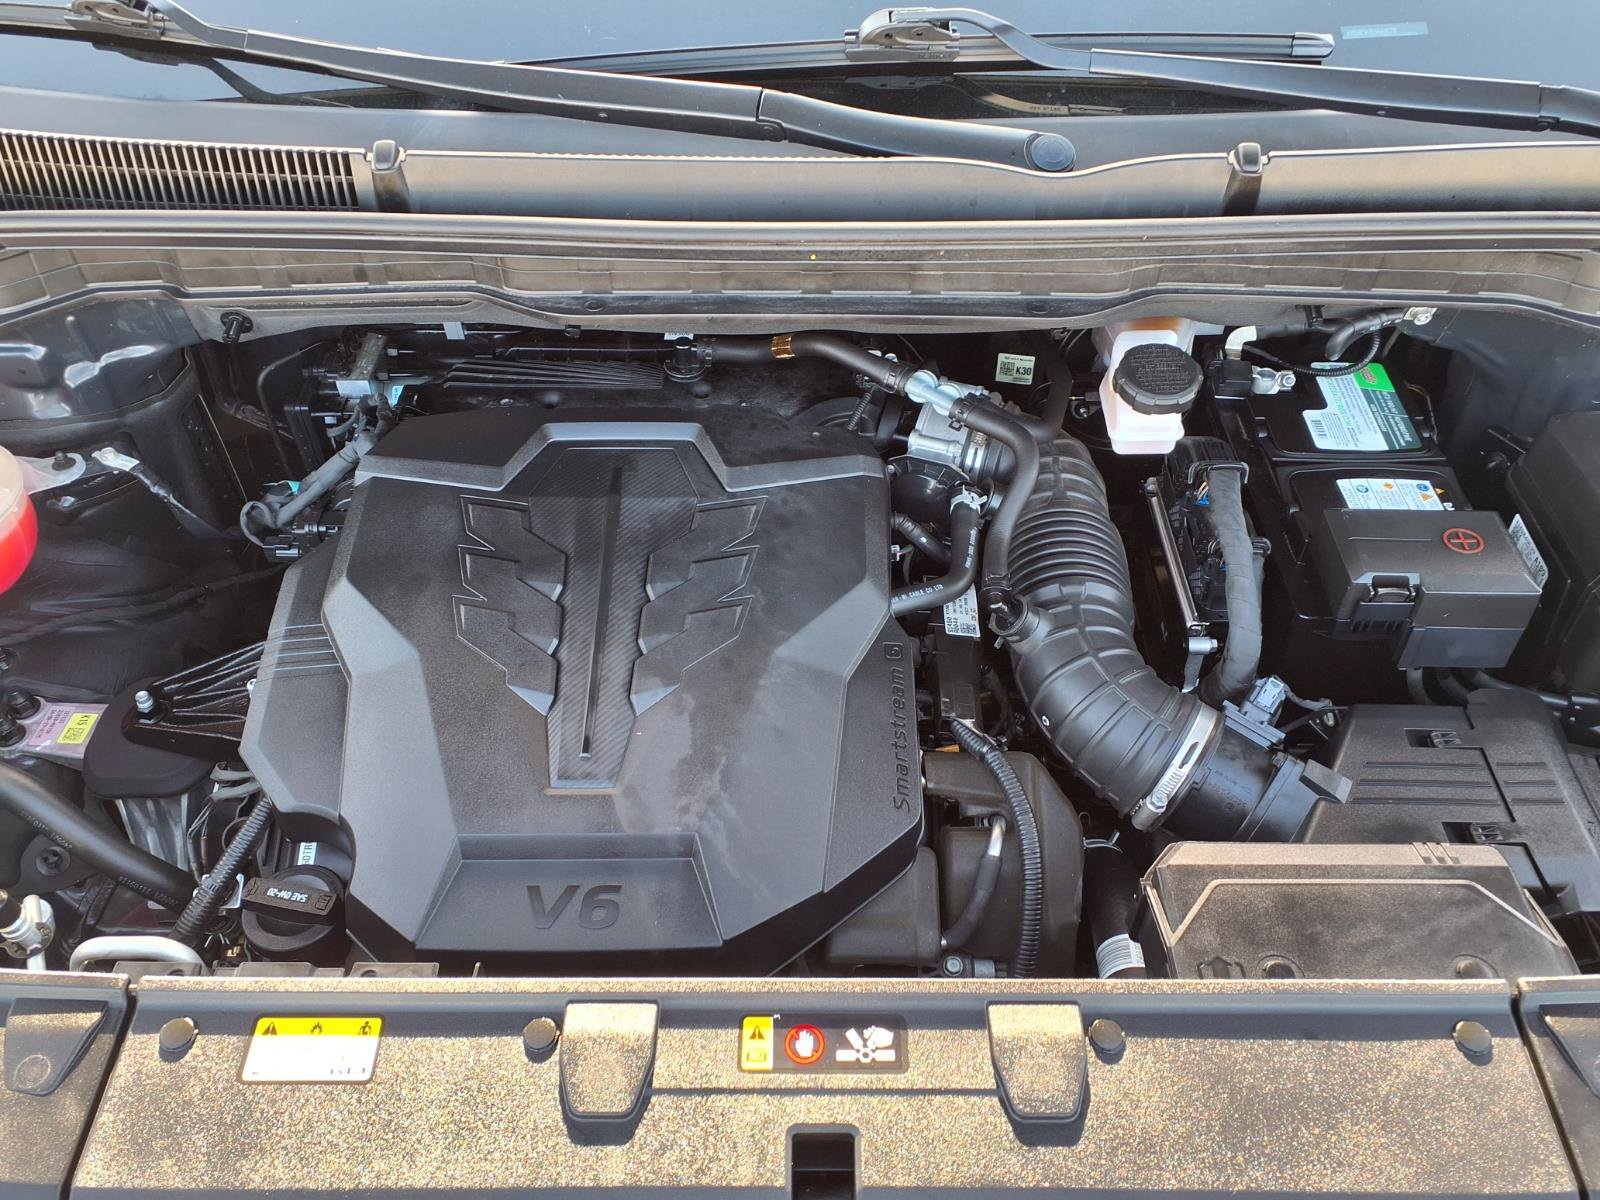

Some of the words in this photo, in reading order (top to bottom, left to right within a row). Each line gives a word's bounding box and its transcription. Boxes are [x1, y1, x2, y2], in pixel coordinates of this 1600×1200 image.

[1015, 366, 1032, 376] K30
[891, 668, 911, 813] Smartstream
[266, 887, 292, 900] 0W-20
[291, 892, 309, 903] SAE
[525, 883, 625, 931] V6
